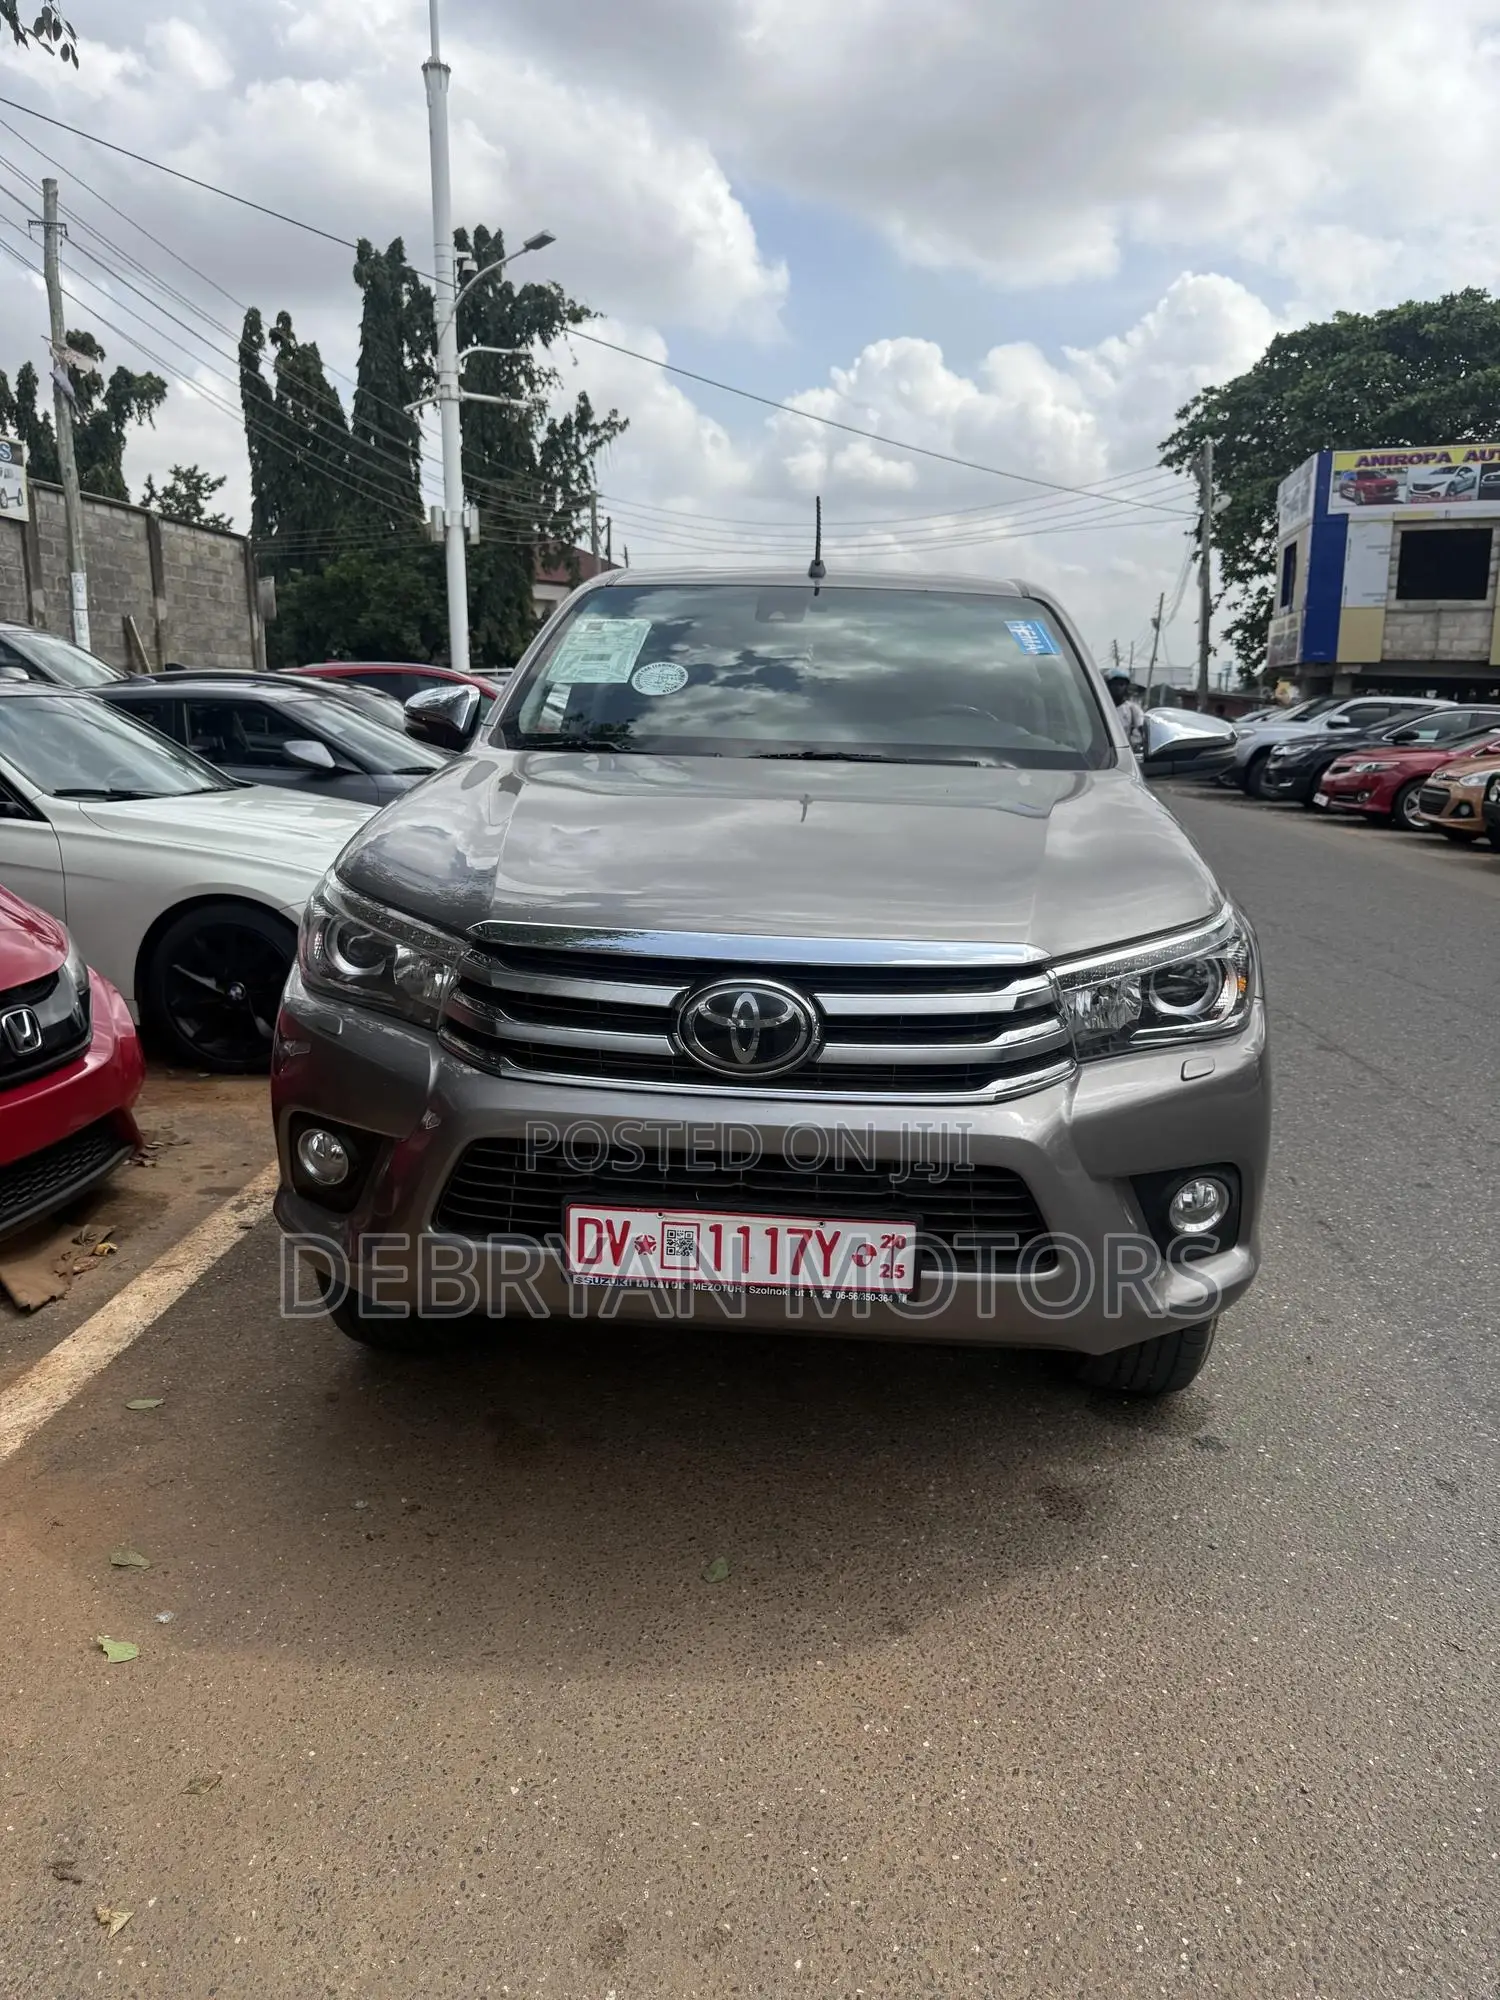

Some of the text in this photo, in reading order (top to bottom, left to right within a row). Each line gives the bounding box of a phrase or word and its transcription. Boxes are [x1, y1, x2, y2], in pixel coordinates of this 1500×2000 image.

[1355, 451, 1452, 467] ANIROPA
[577, 1217, 841, 1277] DV 1117Y
[880, 1234, 907, 1249] 20
[880, 1264, 905, 1279] 25
[584, 1276, 631, 1287] SUZUKI
[835, 1291, 893, 1303] 06-56/350-364
